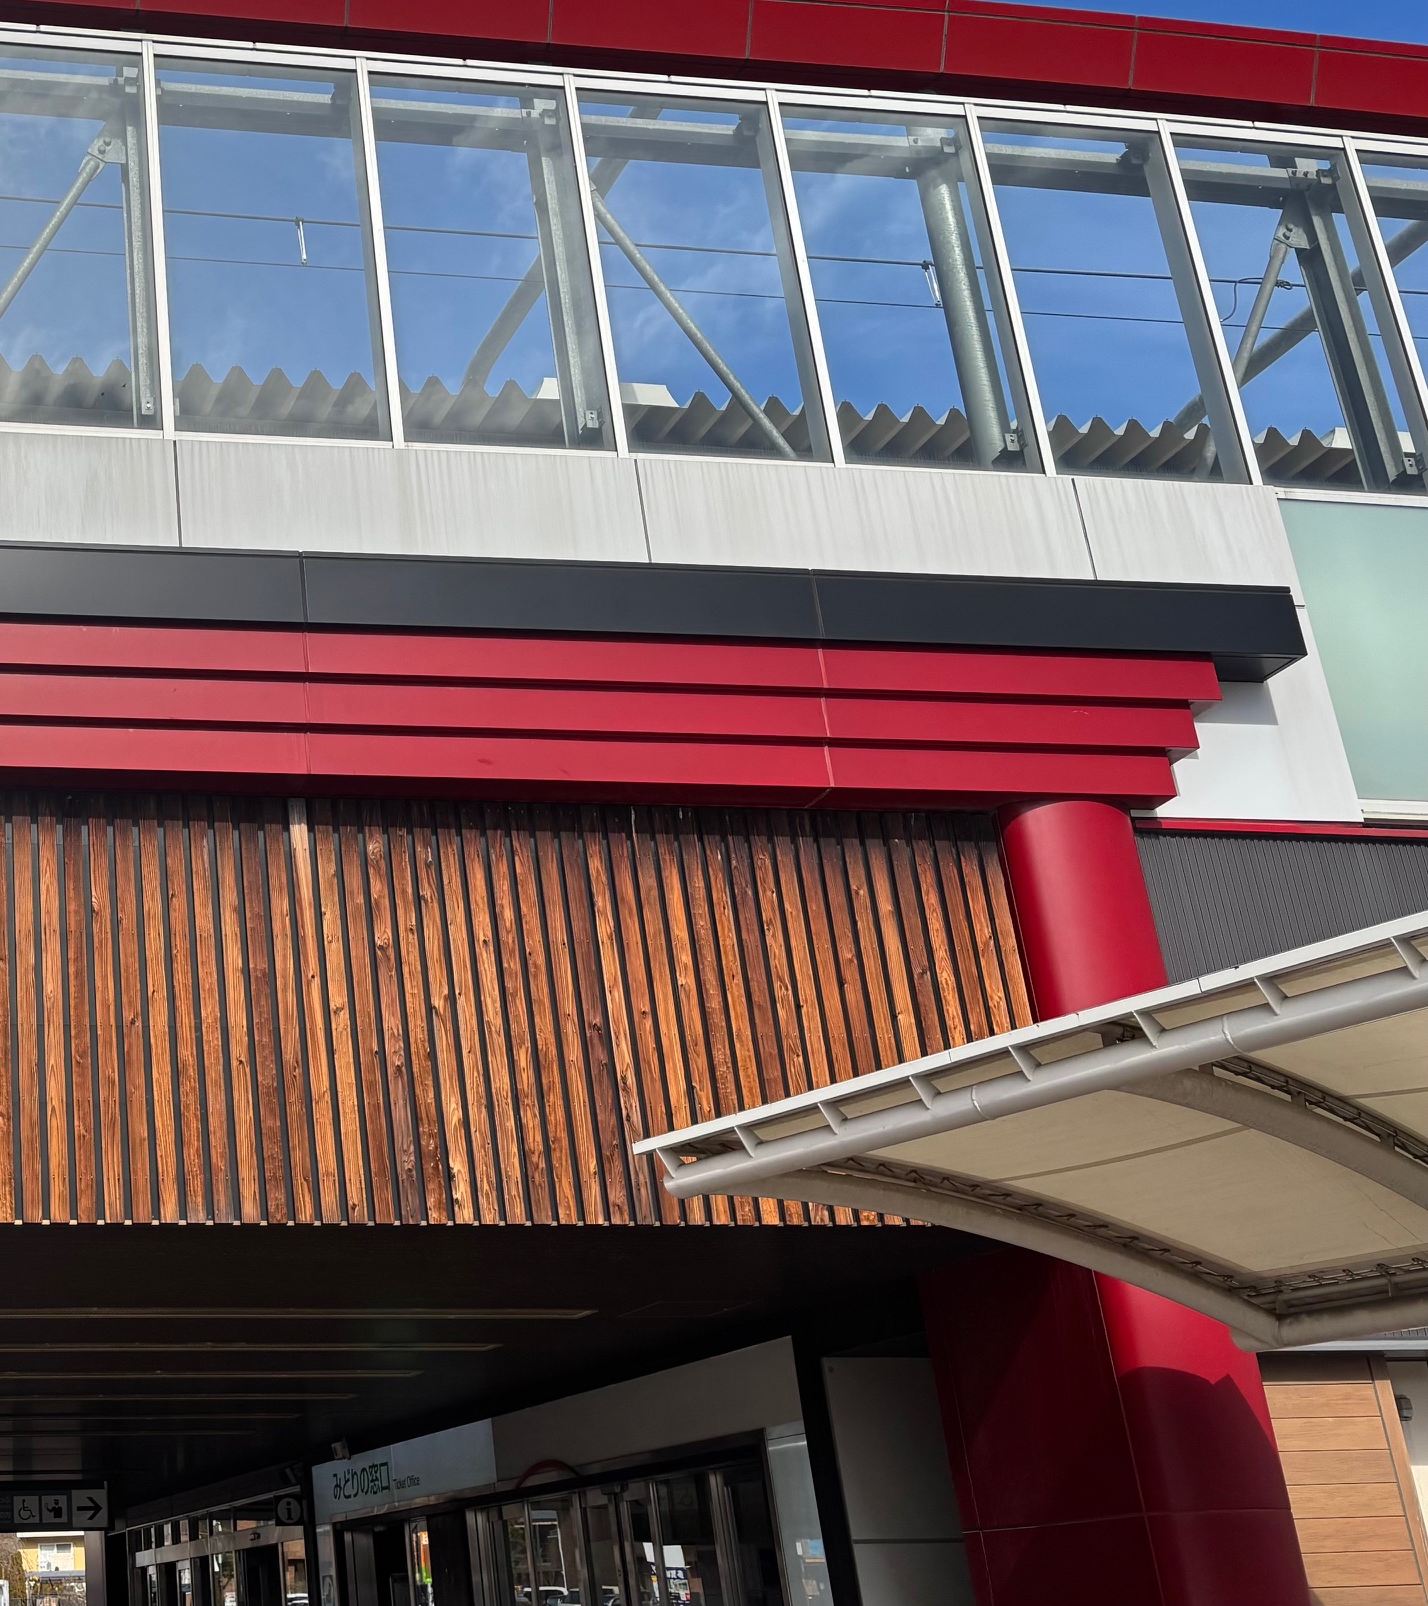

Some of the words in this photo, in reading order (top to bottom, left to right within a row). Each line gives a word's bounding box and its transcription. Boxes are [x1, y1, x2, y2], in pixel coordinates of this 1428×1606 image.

[332, 1462, 391, 1501] みどりの窓口
[406, 1475, 420, 1487] Office
